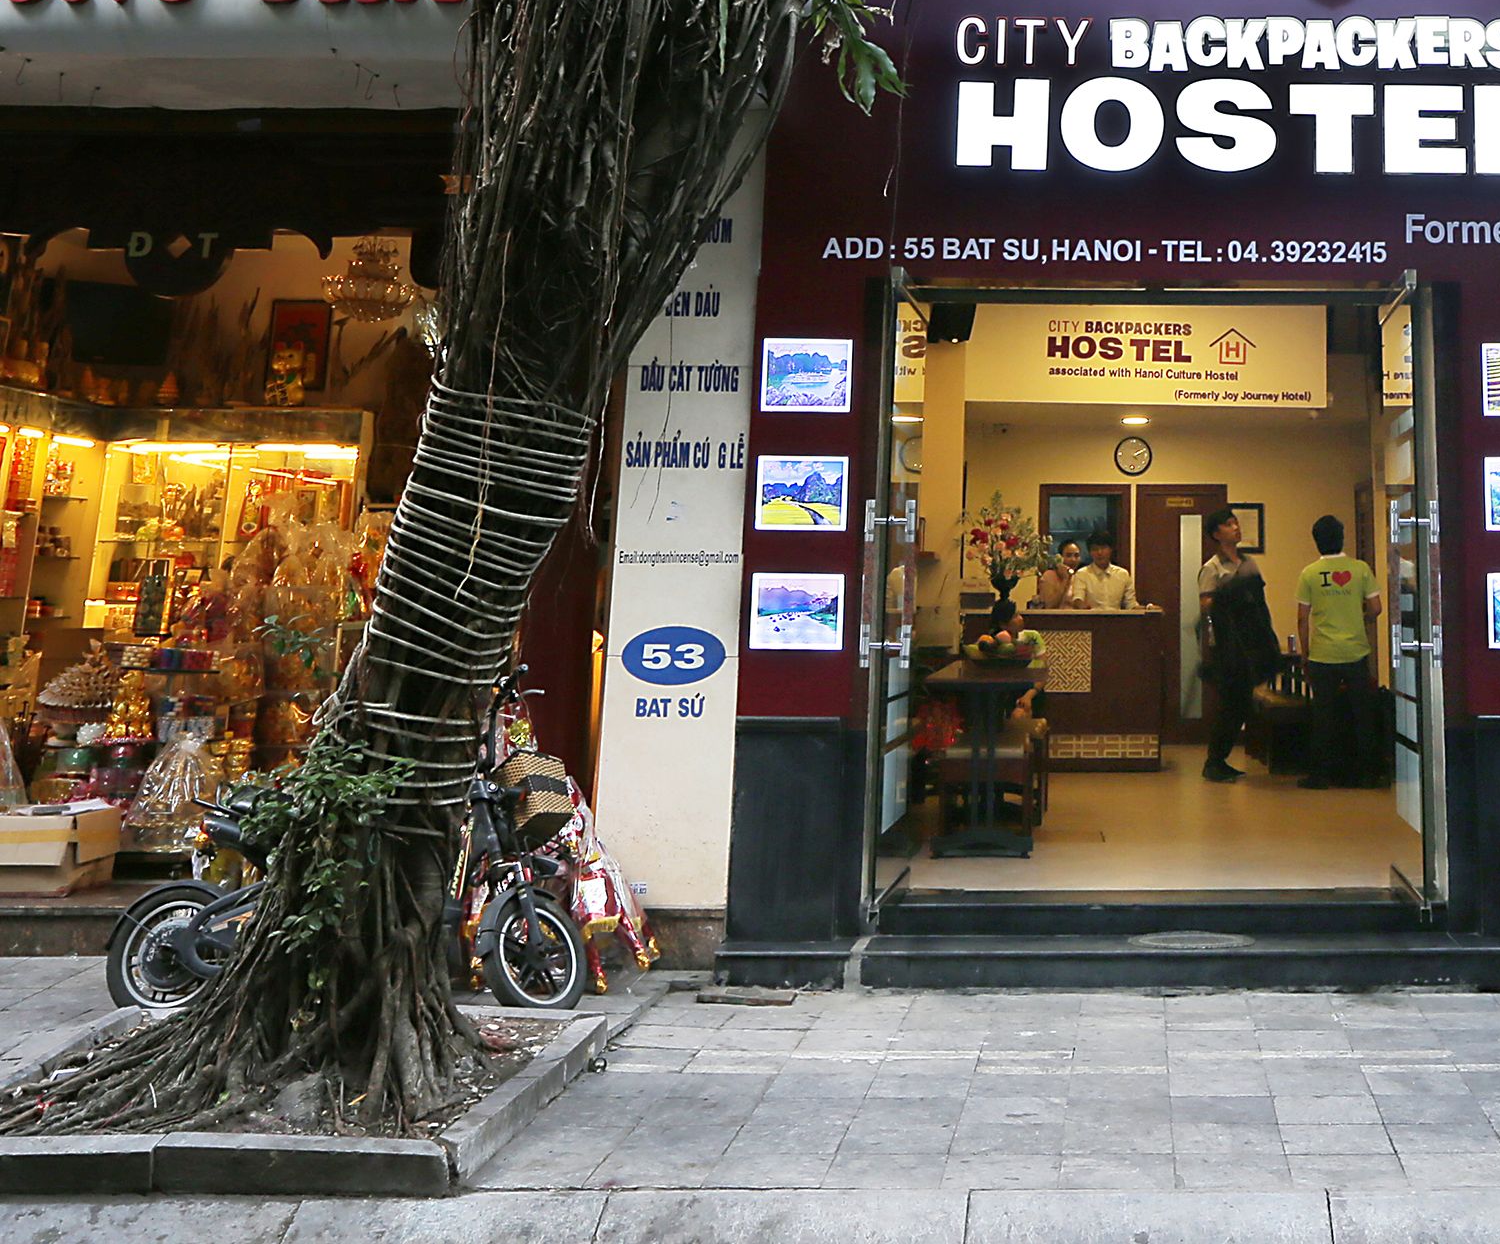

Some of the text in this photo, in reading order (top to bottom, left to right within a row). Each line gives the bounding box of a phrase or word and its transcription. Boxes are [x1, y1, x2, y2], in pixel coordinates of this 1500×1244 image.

[955, 16, 1091, 66] CITY
[903, 237, 936, 259] 55
[942, 237, 996, 260] BAT
[1048, 320, 1193, 336] CITY BACKPACKERS
[1048, 366, 1239, 382] associated with Hanoi Culture Hostel
[1174, 389, 1312, 403] (Formerly Joy Journey Hotel)
[640, 643, 706, 670] 53
[635, 698, 673, 719] BAT
